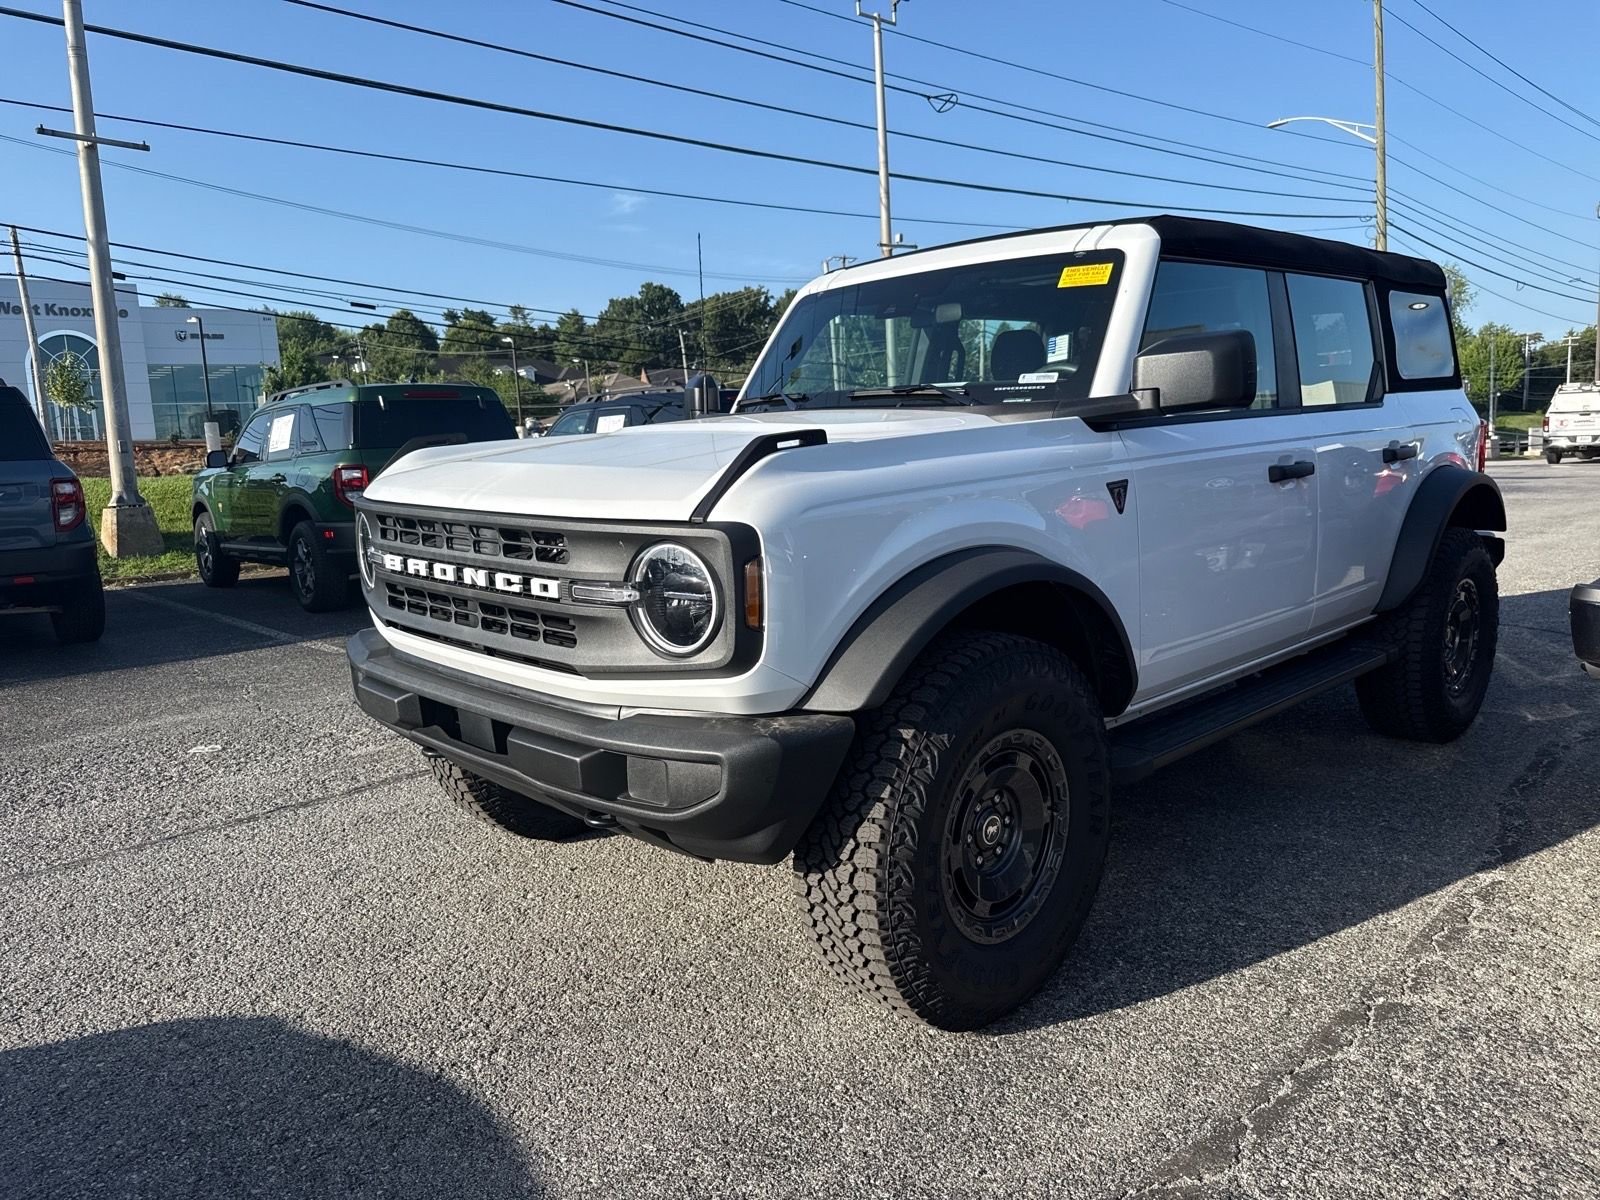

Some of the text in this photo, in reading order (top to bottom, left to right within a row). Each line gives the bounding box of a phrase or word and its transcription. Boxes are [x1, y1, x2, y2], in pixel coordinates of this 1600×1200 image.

[0, 302, 129, 318] Wet Knoxe
[383, 553, 562, 599] BRONCO
